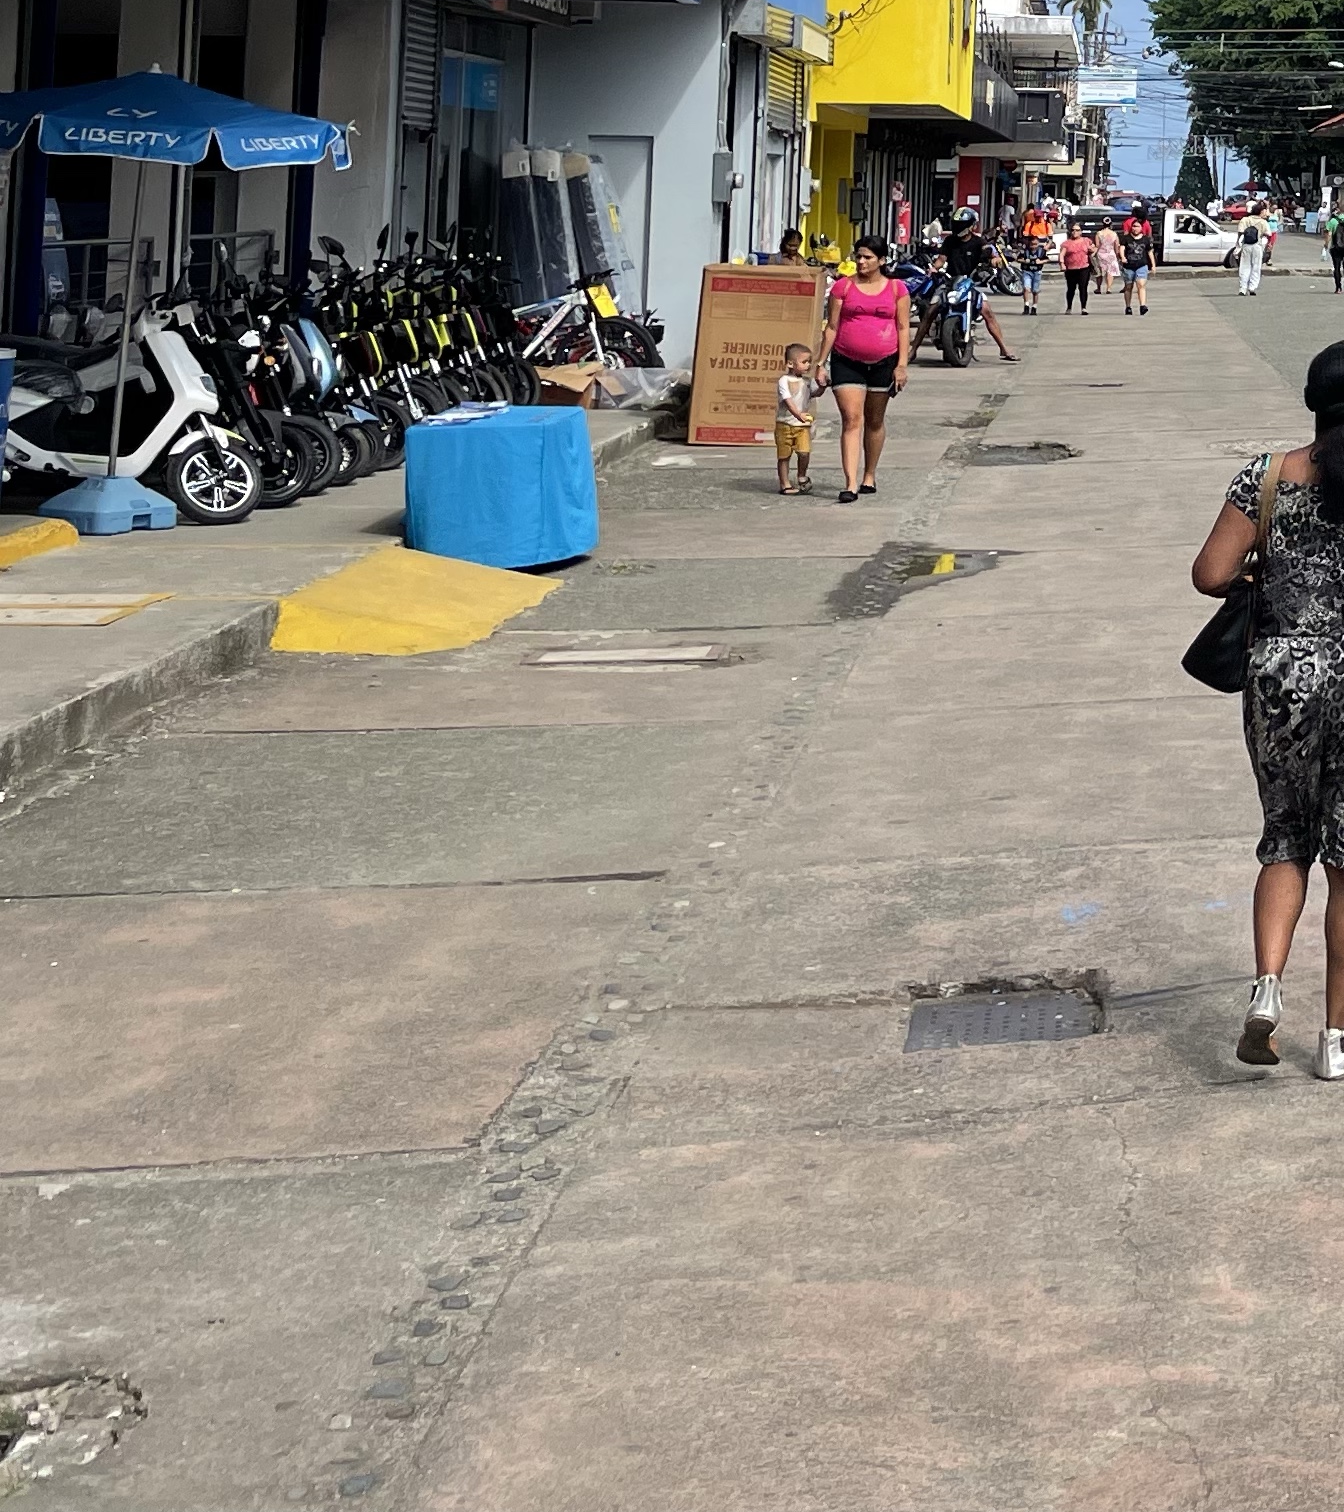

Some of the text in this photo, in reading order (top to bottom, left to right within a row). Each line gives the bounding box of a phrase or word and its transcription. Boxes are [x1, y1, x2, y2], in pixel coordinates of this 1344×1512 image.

[64, 127, 181, 148] LIBERTY
[240, 133, 320, 152] LIBERTY
[722, 341, 784, 358] UISINIÈRE
[709, 357, 787, 372] NGE ESTUFA
